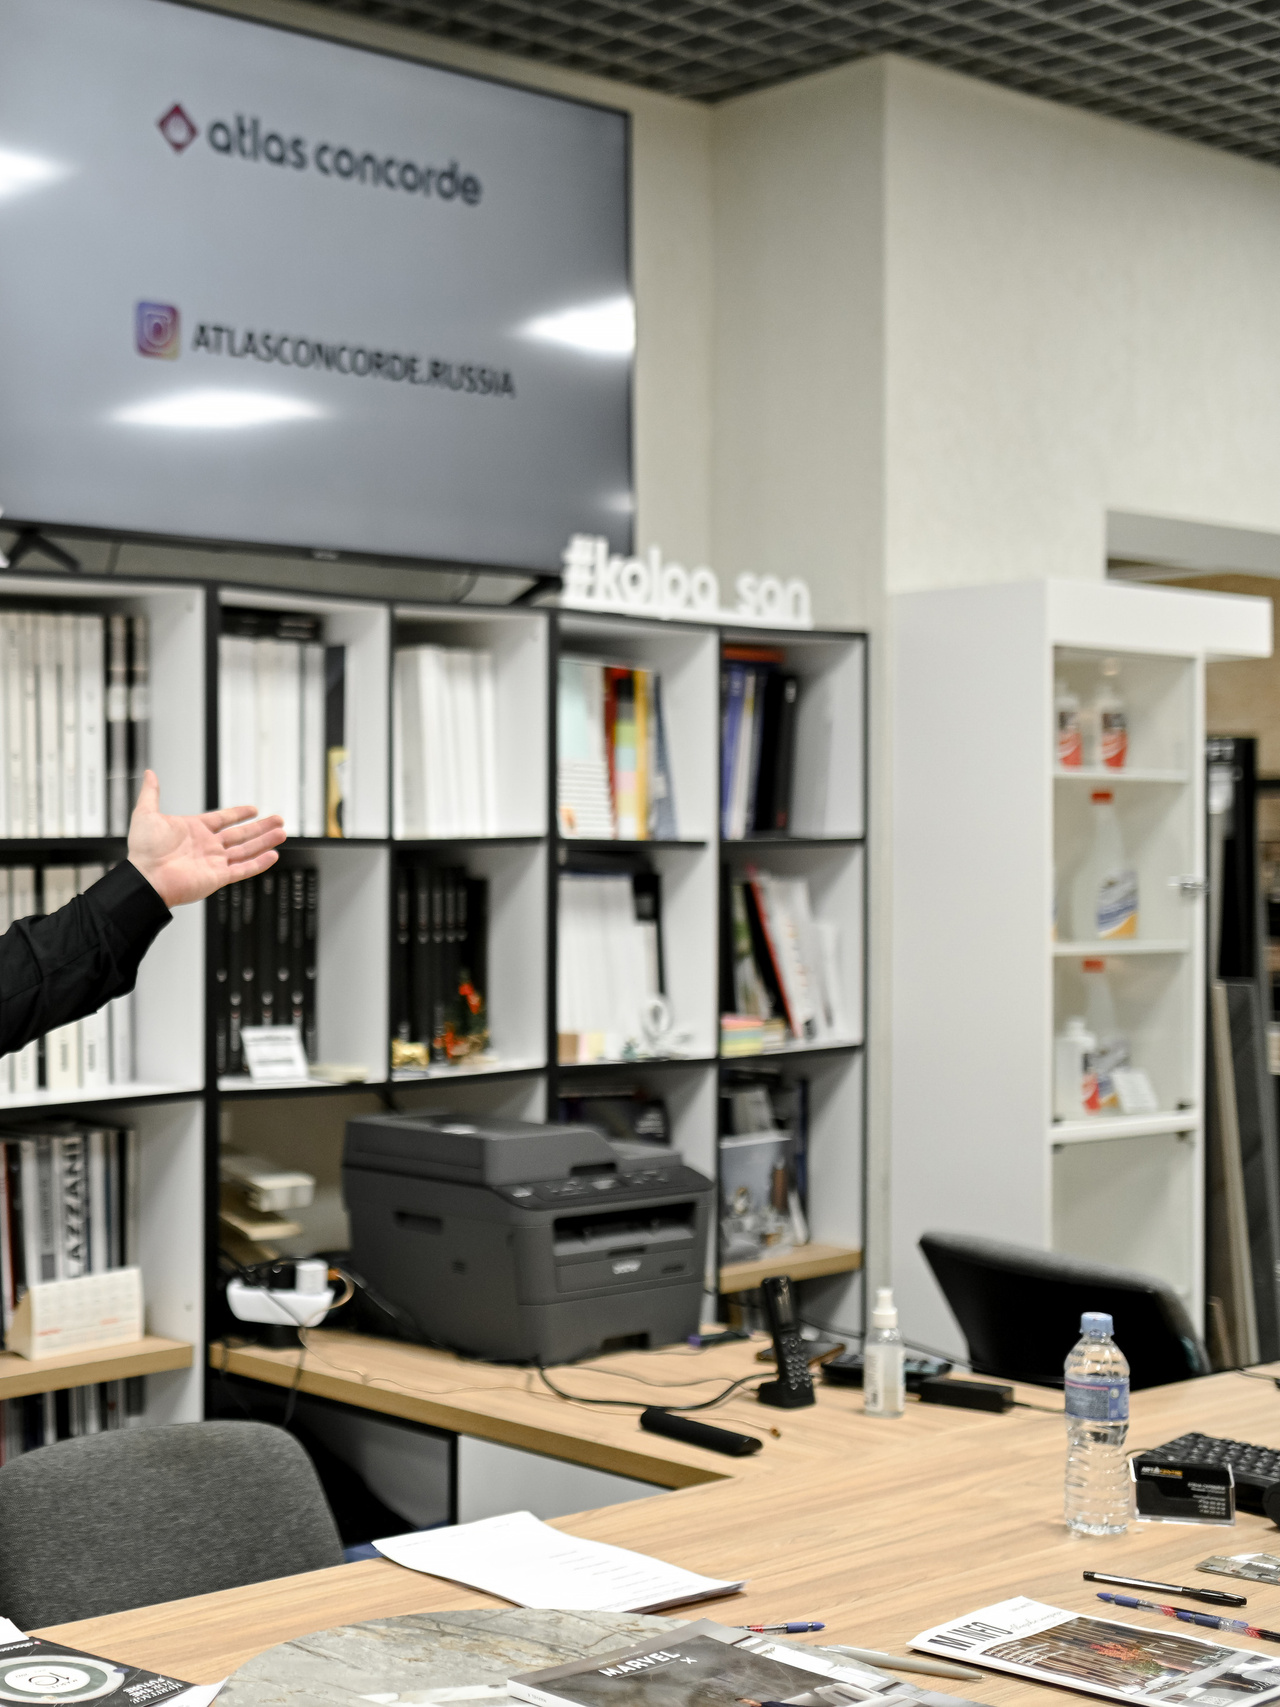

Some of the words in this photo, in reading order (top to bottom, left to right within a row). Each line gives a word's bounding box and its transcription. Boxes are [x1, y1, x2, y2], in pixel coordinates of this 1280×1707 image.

[207, 113, 306, 171] atlas
[317, 144, 484, 206] concorde
[192, 323, 517, 399] ATLASCONCORDE.RUSSIA
[946, 1621, 1014, 1643] INFO
[598, 1651, 681, 1677] MARVEL
